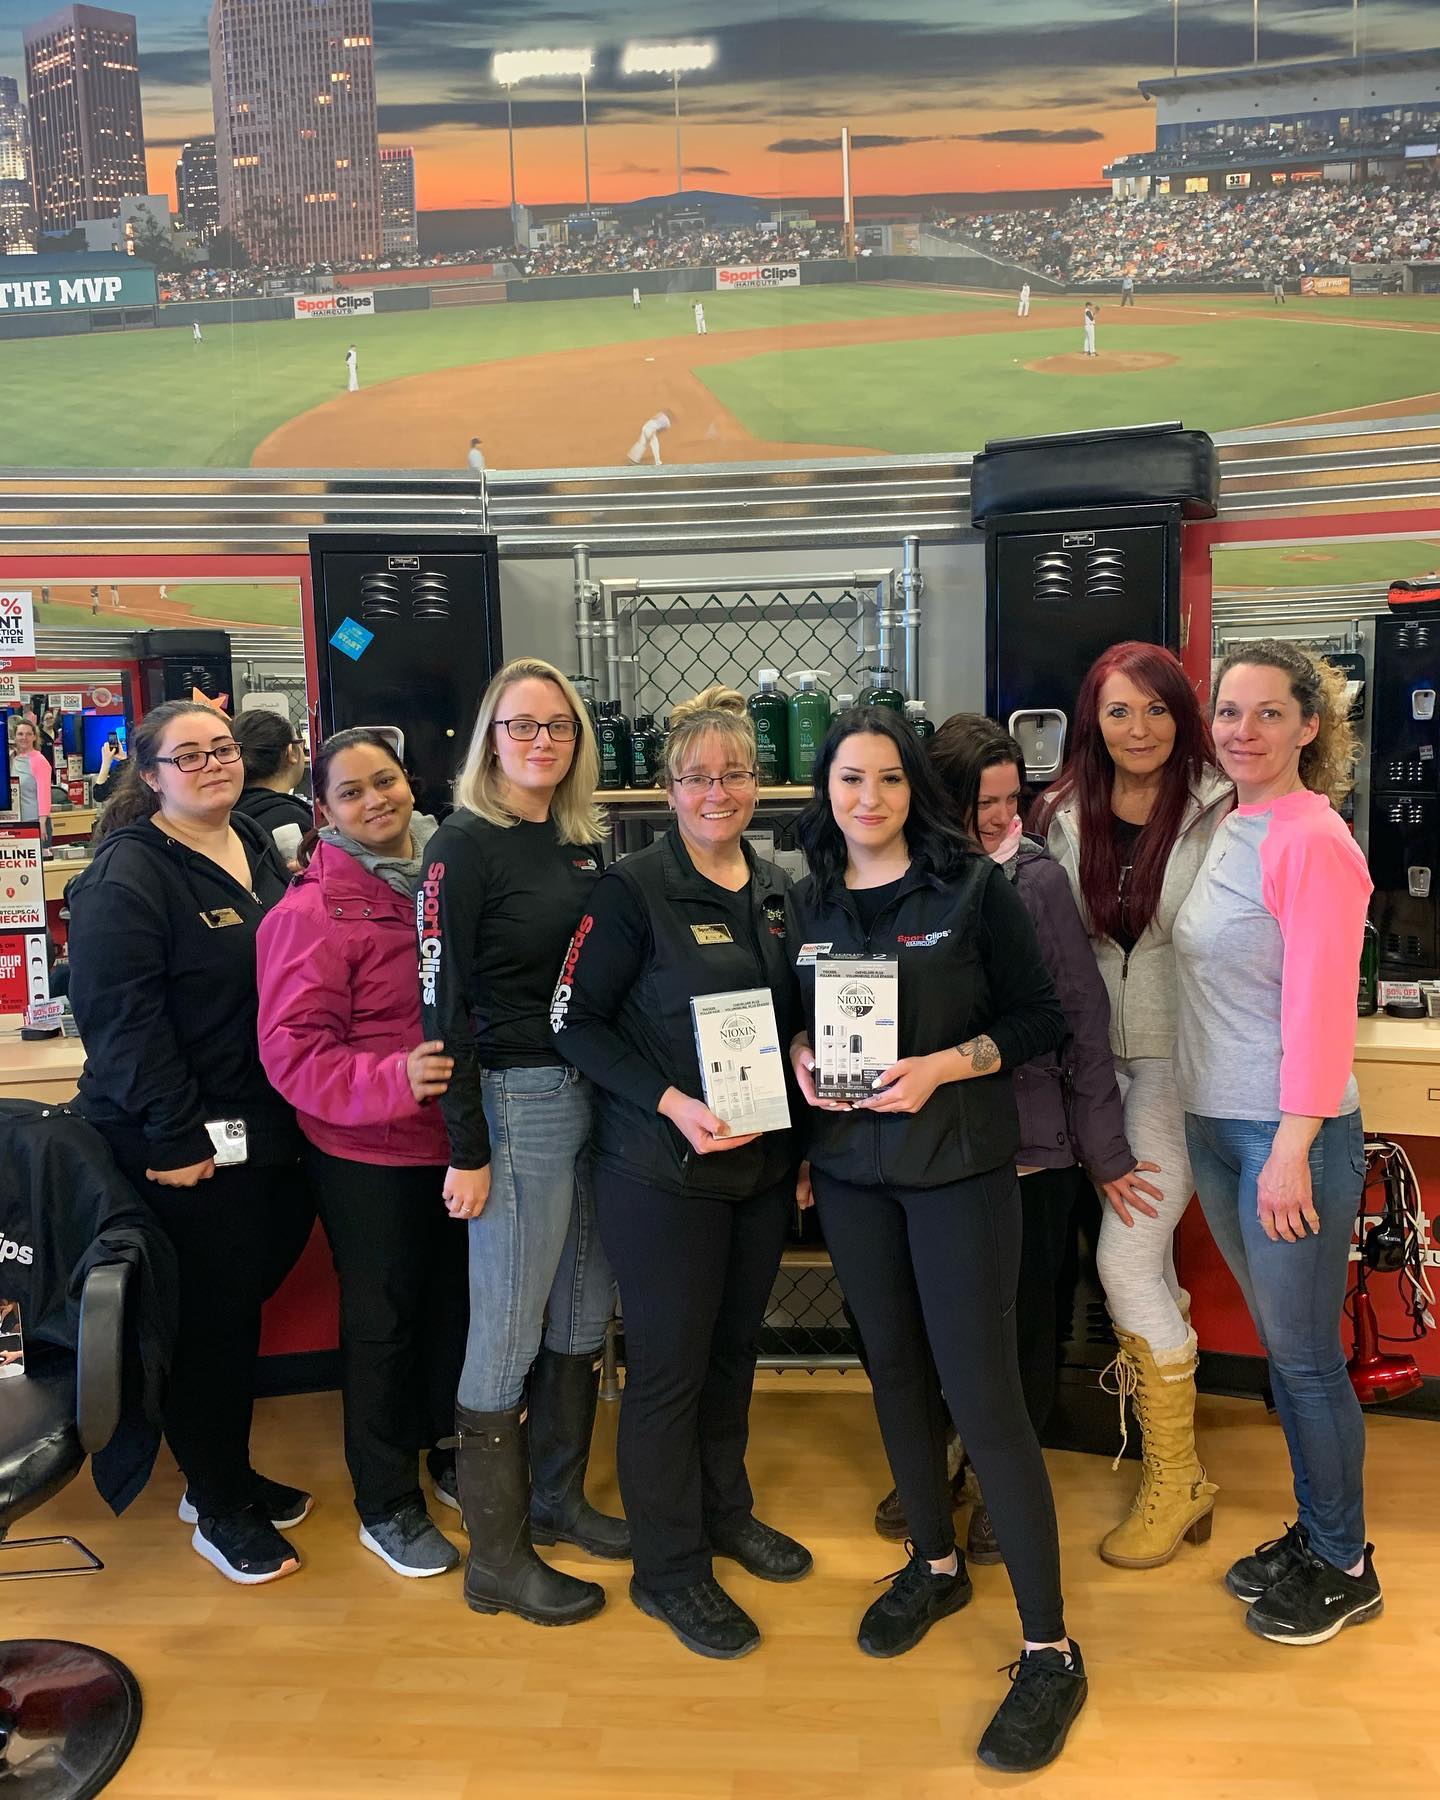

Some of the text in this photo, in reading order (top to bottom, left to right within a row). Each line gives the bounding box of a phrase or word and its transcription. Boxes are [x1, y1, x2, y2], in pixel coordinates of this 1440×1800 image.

[719, 267, 798, 283] SportClips
[734, 280, 778, 288] HAIRCUTS
[0, 276, 122, 308] THE MVP
[297, 296, 372, 312] SportClips
[0, 849, 36, 859] LINE
[25, 860, 37, 868] IN
[419, 862, 445, 1007] SportClips
[1404, 988, 1418, 996] OFF
[838, 996, 875, 1005] NIOXIN
[48, 1005, 60, 1013] OFF
[856, 1005, 865, 1017] 2
[720, 1026, 757, 1039] NIOXIN
